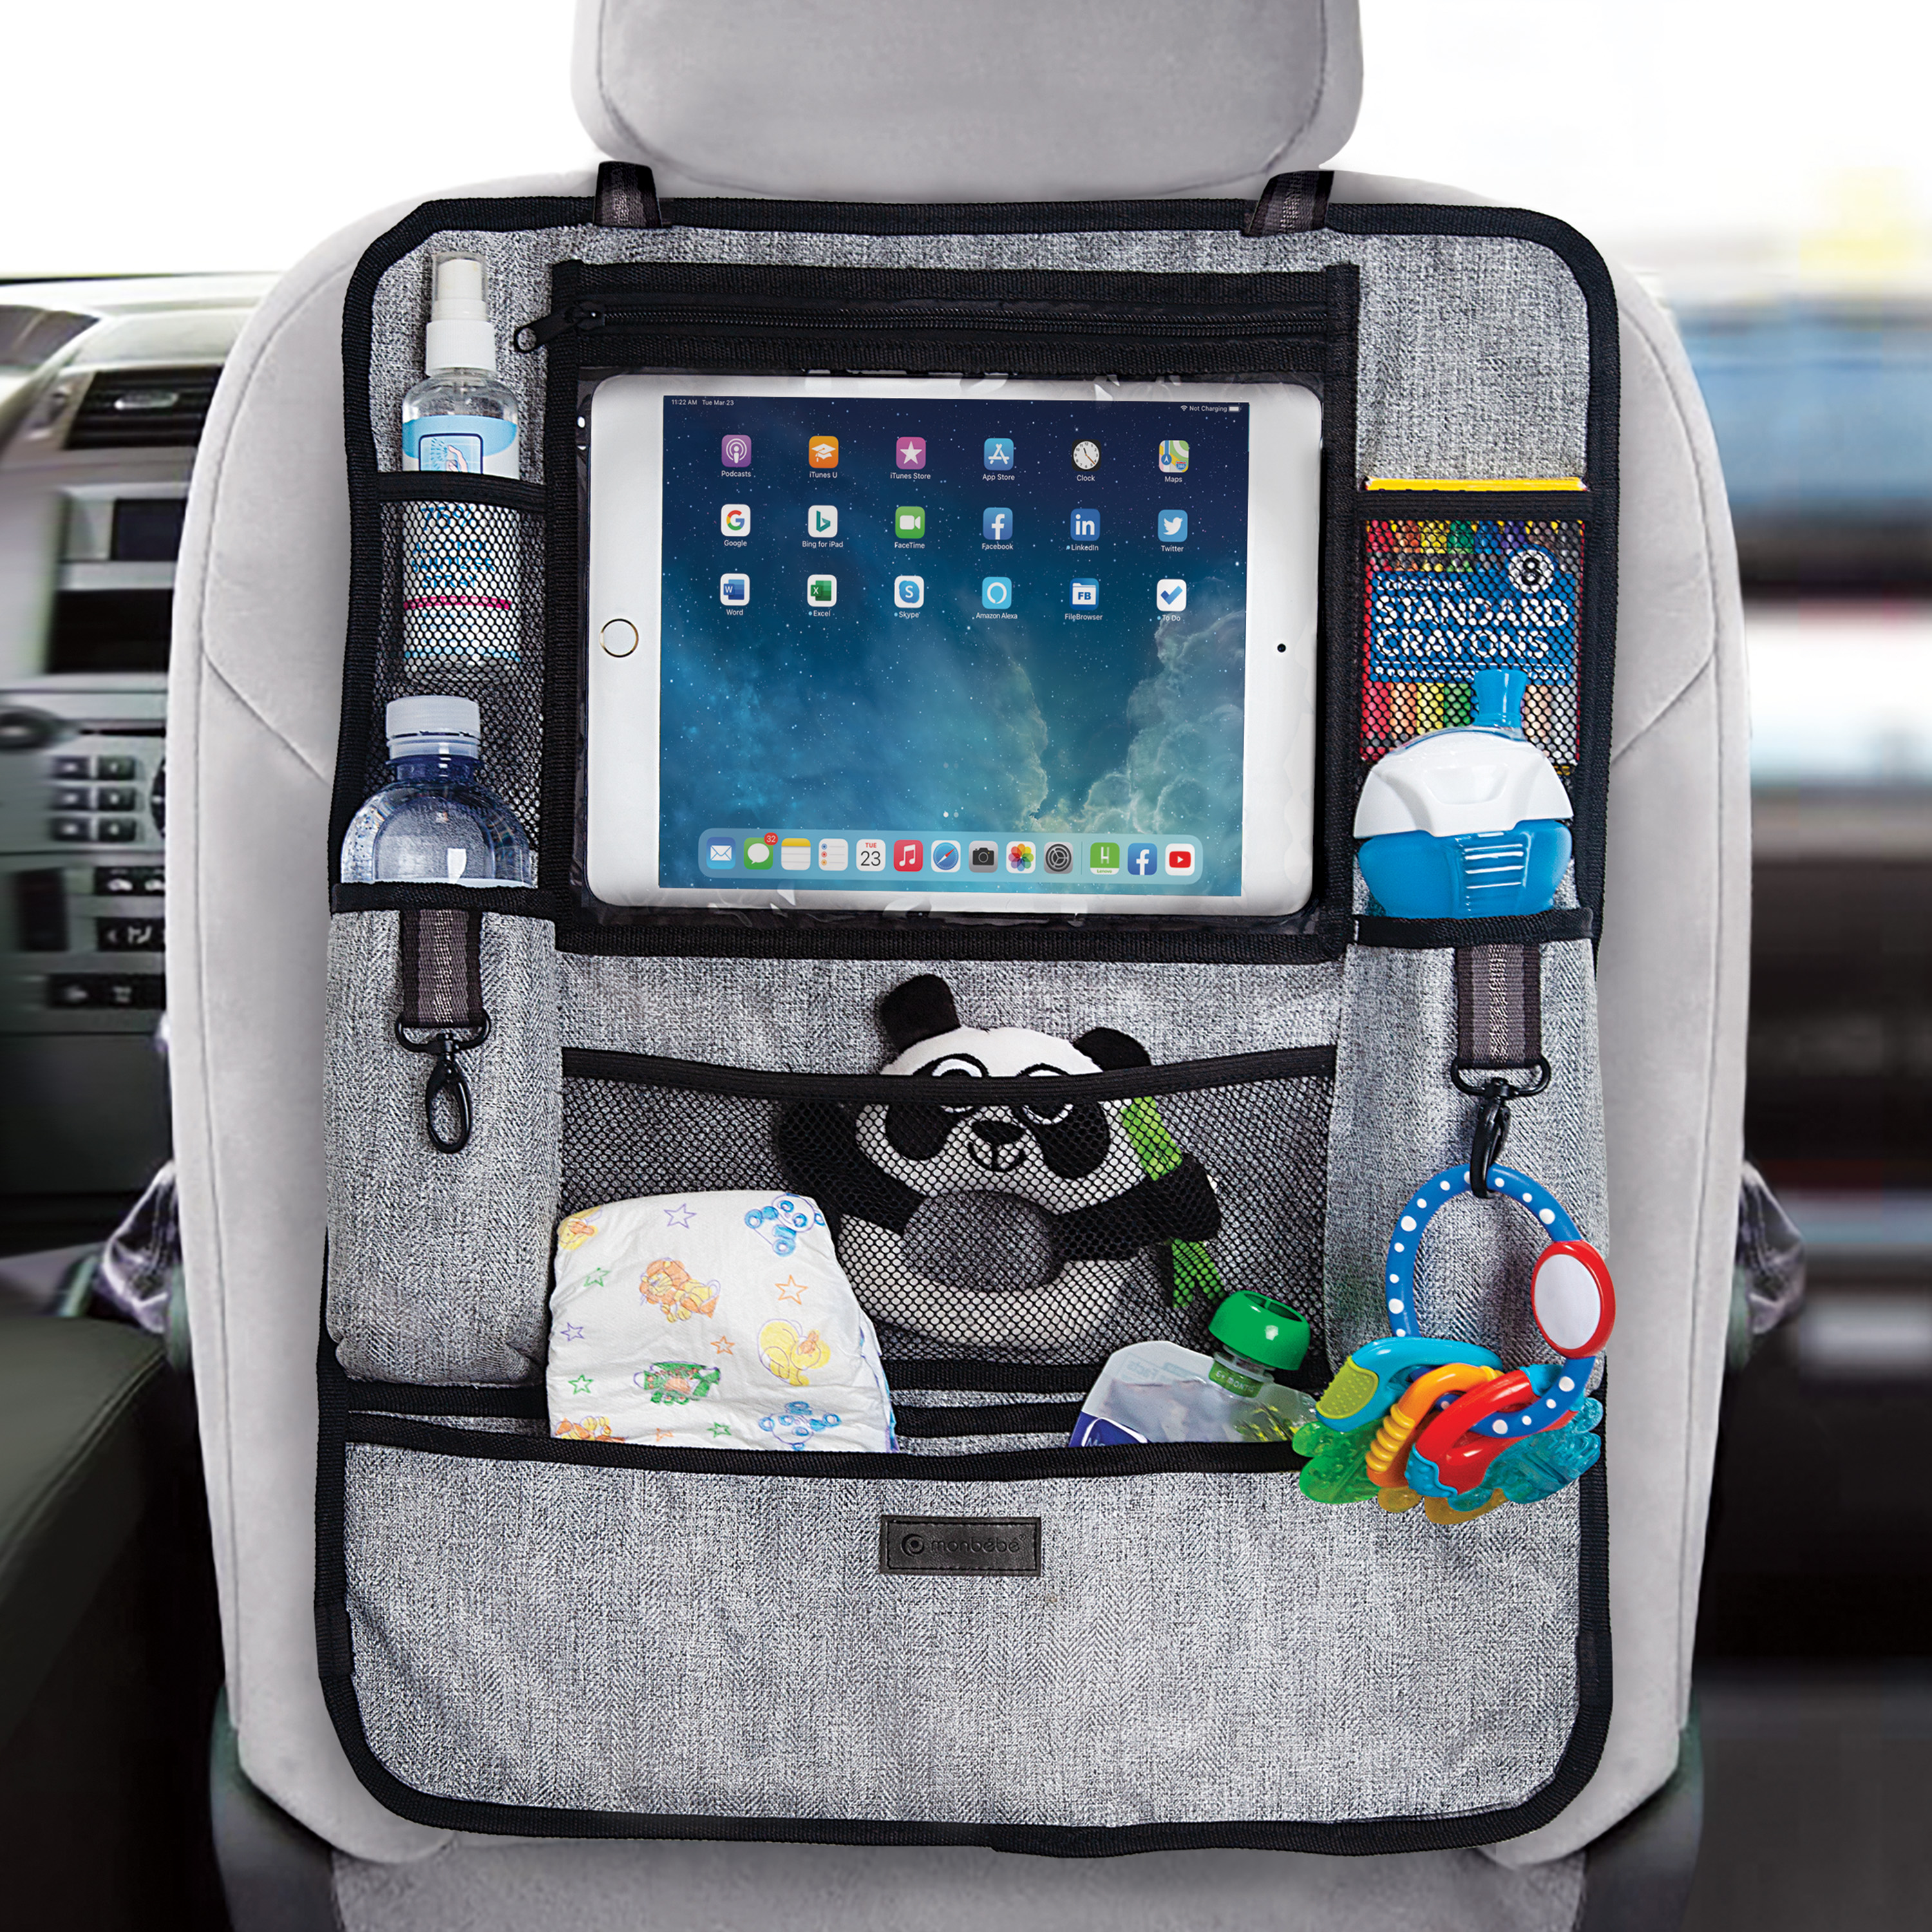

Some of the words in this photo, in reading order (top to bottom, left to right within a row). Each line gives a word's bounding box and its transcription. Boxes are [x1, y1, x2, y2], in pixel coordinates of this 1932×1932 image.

[1200, 405, 1227, 413] Charging
[982, 473, 996, 482] App
[1075, 514, 1095, 536] in
[412, 539, 493, 555] ACOHO
[723, 539, 748, 548] Google
[802, 540, 817, 549] Bing
[981, 542, 1014, 551] Facebook
[1071, 544, 1099, 552] LinkedIn
[1077, 591, 1092, 601] FB
[898, 611, 920, 620] Skype
[1376, 595, 1570, 627] STANDARD
[1065, 613, 1103, 621] FileBrowser
[1376, 627, 1550, 659] CRAYONS
[766, 835, 777, 844] 32
[860, 850, 882, 867] 23
[931, 1536, 1020, 1553] monbébé
